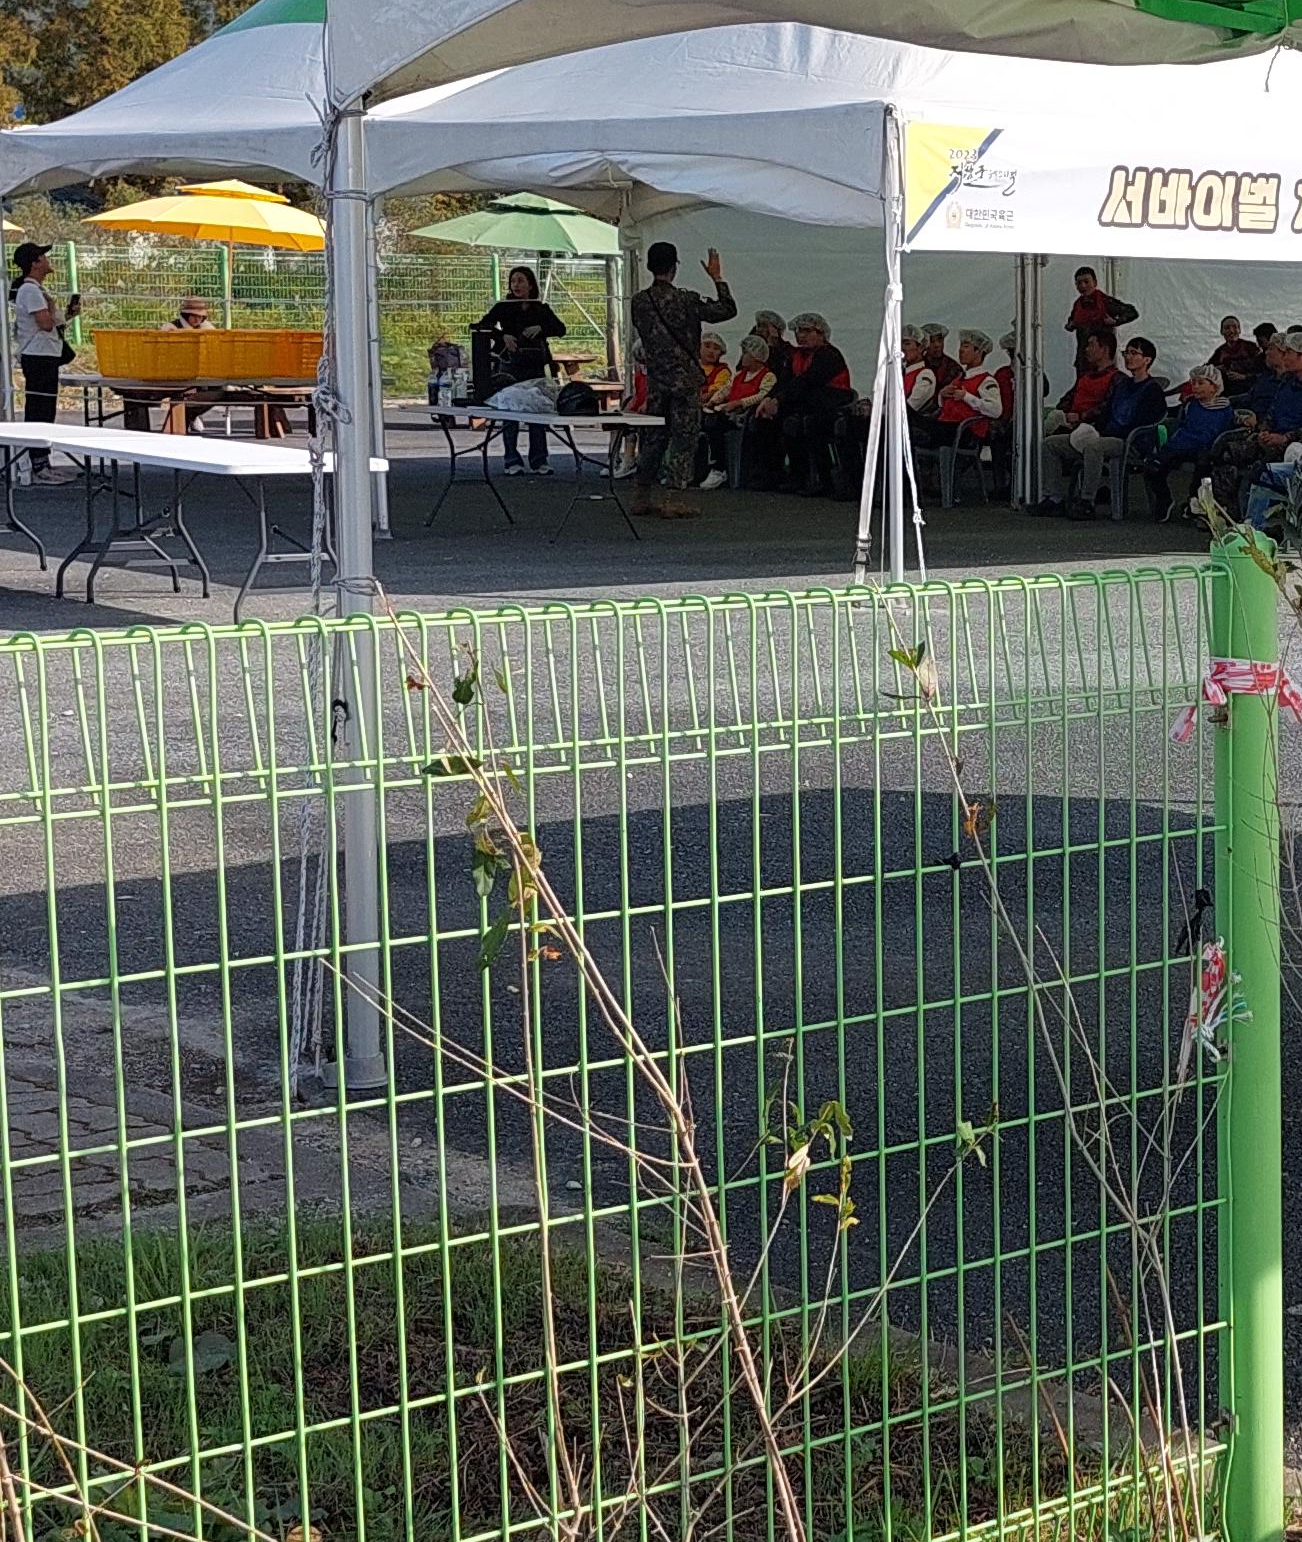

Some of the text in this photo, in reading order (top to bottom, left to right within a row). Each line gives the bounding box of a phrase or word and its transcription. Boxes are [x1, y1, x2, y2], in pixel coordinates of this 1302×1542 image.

[949, 148, 977, 160] 2023
[1098, 165, 1281, 234] 서바이벌
[965, 208, 1014, 222] 대한민국육군
